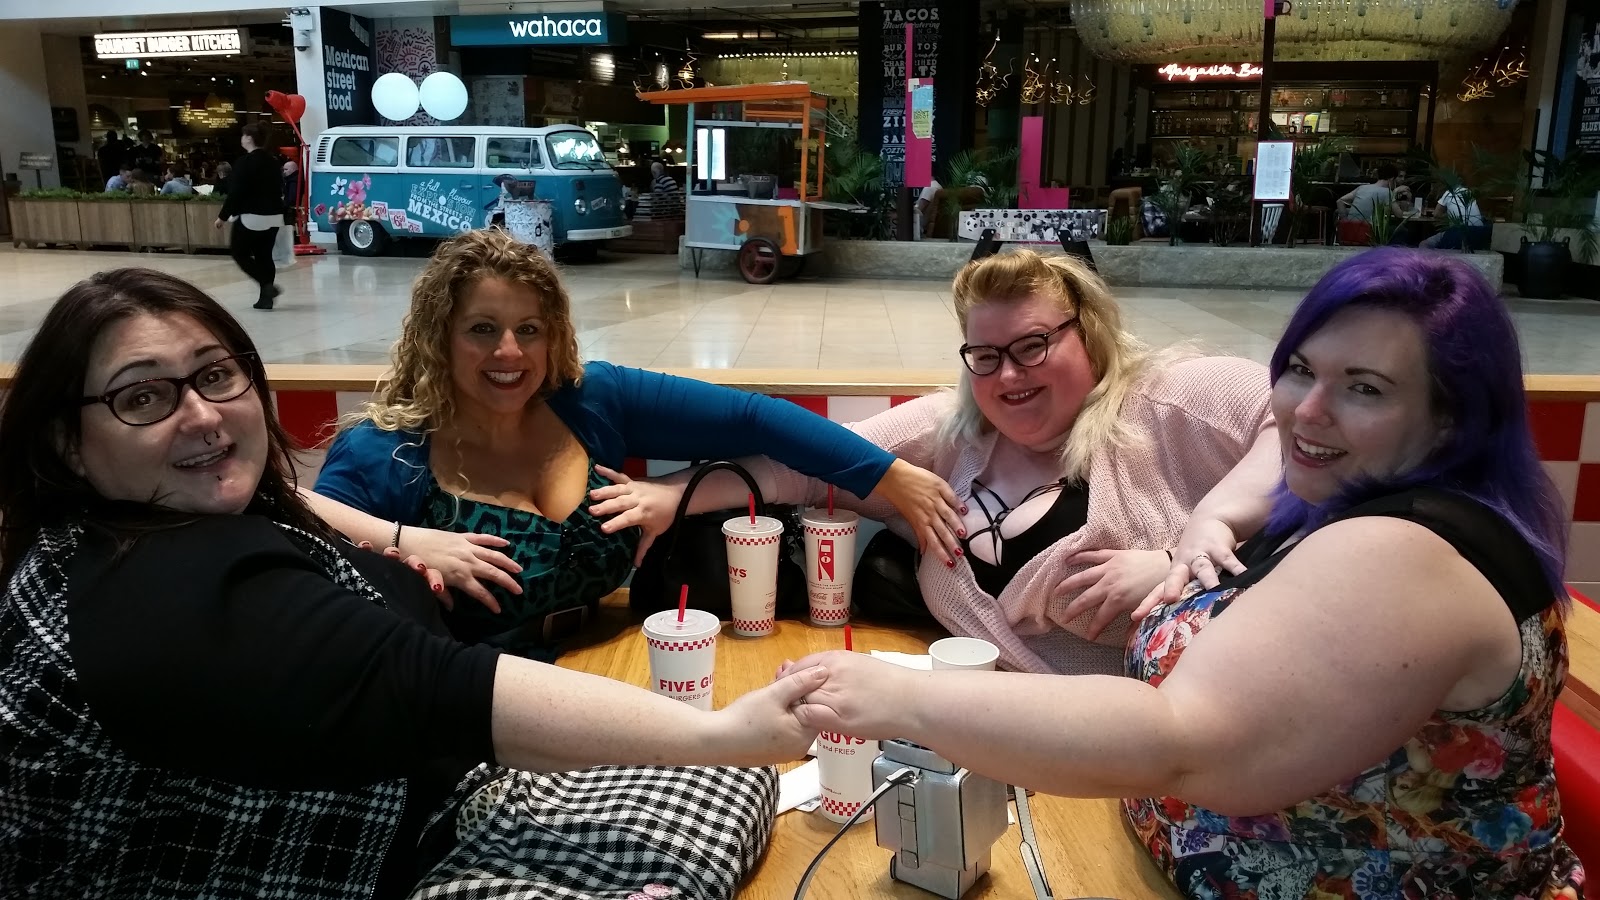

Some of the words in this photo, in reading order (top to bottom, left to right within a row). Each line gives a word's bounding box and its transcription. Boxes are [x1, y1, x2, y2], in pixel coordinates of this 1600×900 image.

[883, 8, 939, 21] TACOS
[508, 16, 602, 37] wahaca
[95, 37, 146, 54] GOURMET
[146, 35, 191, 53] BURGER
[191, 33, 241, 50] KITCHEN
[324, 45, 370, 72] Mexican
[326, 68, 356, 91] street
[883, 66, 937, 77] METS
[327, 89, 353, 111] food
[407, 198, 472, 234] MEXICO
[728, 564, 748, 578] UYS
[659, 679, 696, 692] FIVE
[834, 747, 856, 756] FRIES
